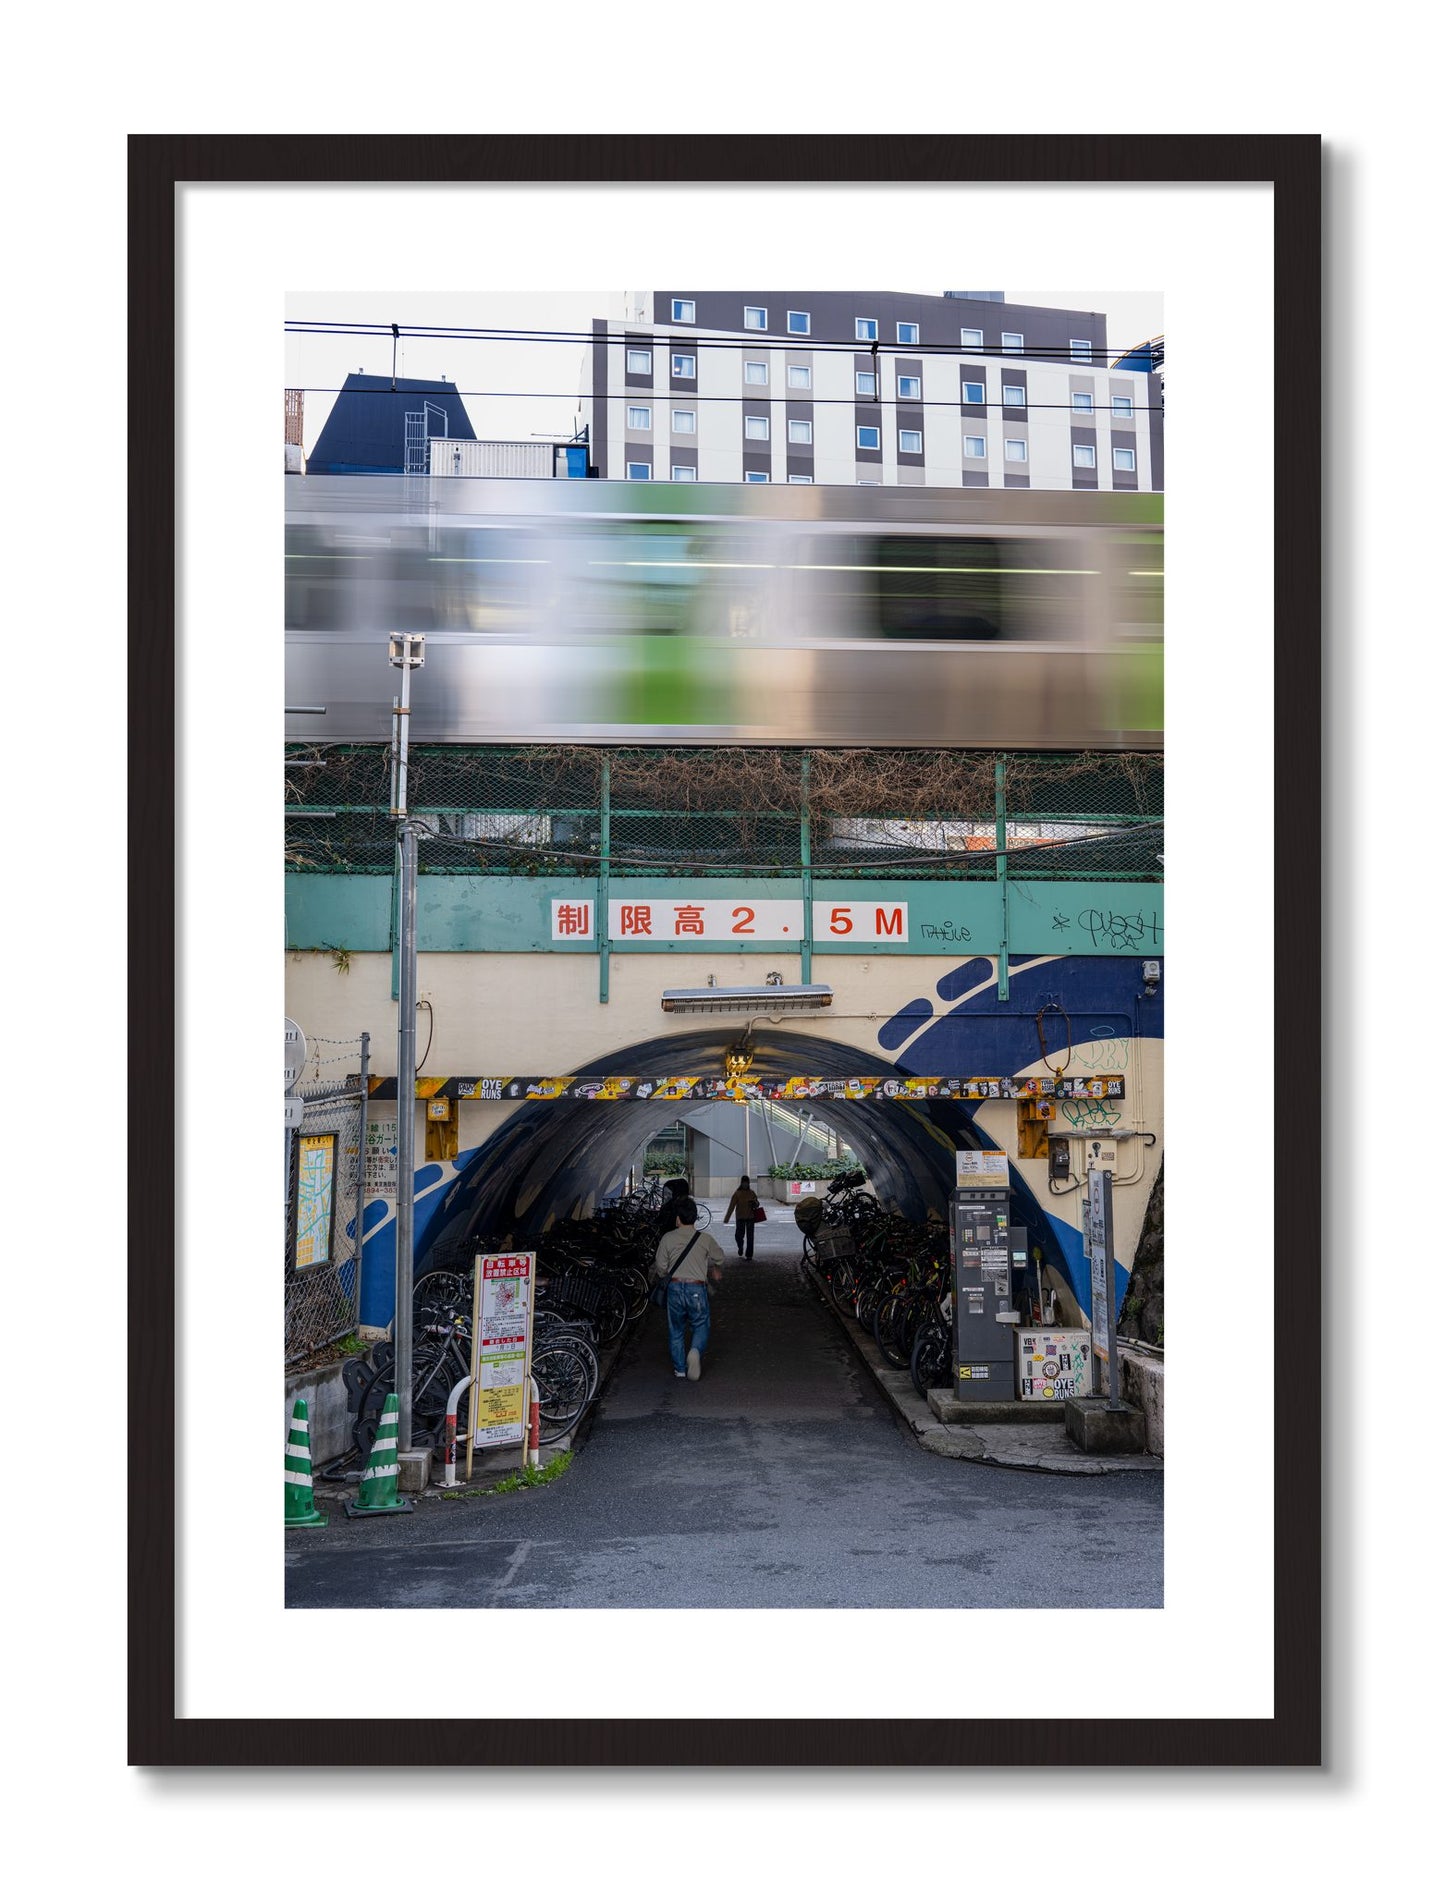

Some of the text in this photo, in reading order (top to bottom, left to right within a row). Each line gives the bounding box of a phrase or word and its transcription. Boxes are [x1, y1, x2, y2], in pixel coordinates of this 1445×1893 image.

[482, 1079, 502, 1089] OYE
[481, 1089, 502, 1100] RUNS
[1054, 1379, 1074, 1389] OYE
[1054, 1389, 1075, 1400] RUNS
